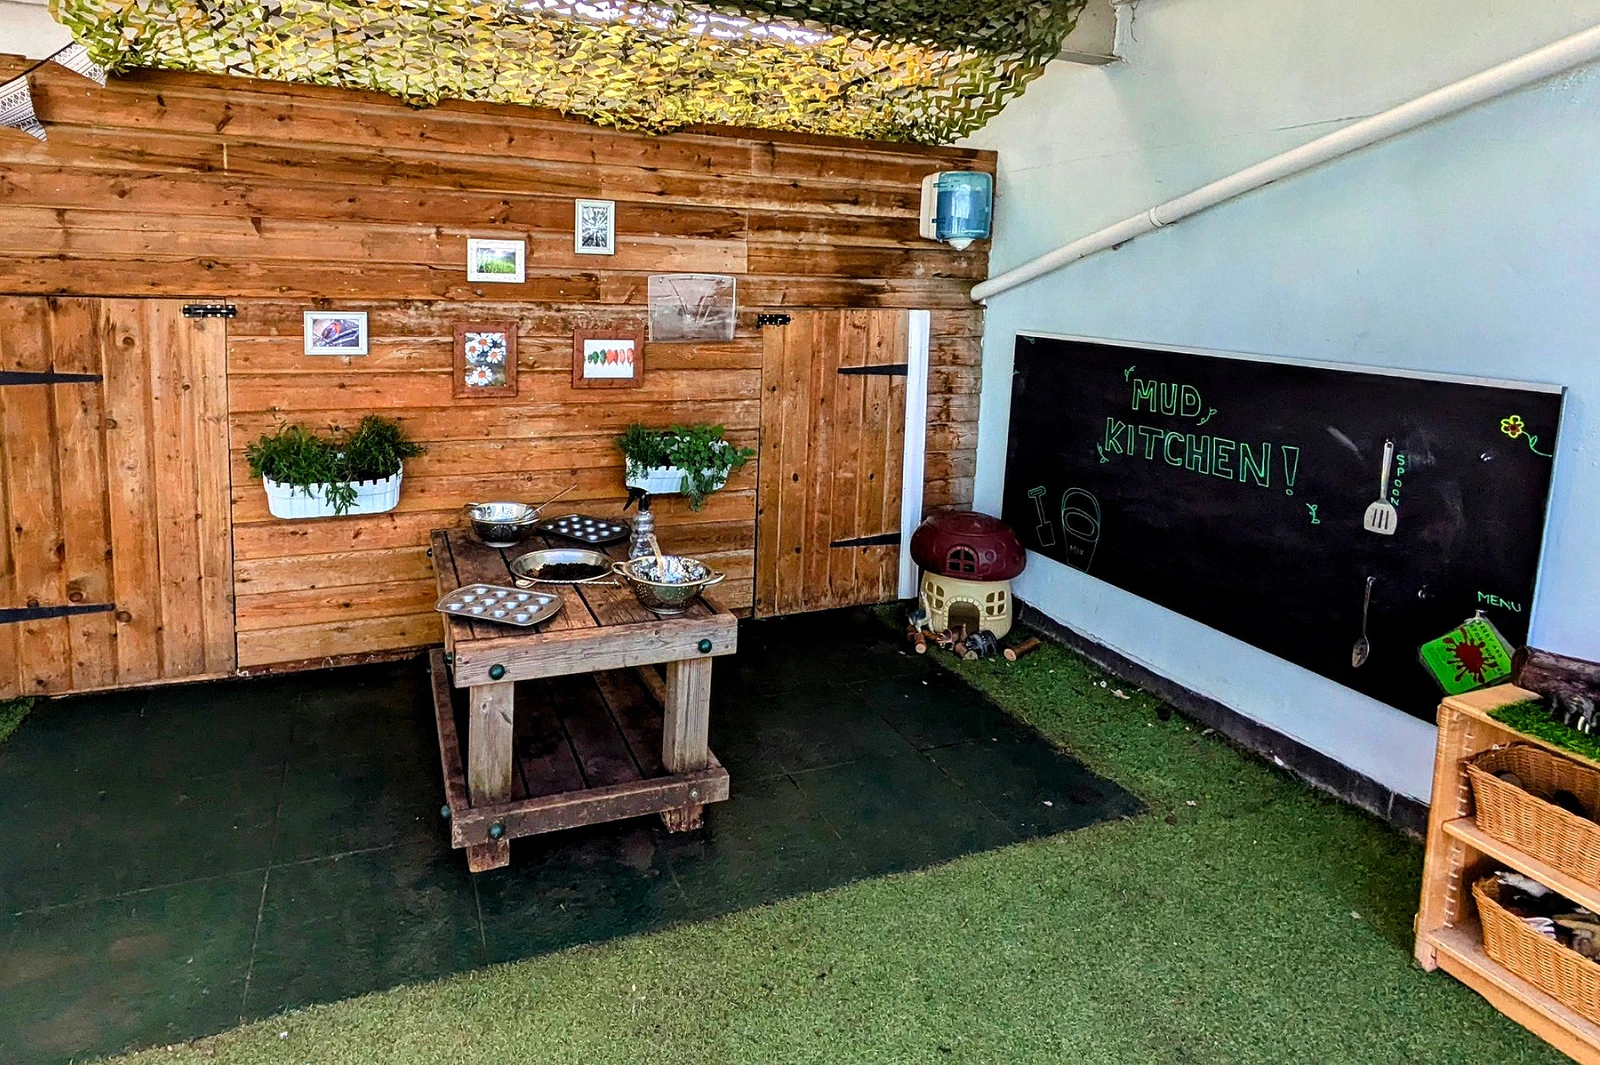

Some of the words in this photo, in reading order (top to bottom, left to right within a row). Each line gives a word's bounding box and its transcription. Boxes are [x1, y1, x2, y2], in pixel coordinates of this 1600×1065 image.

[1131, 378, 1201, 417] MUD
[1390, 454, 1406, 506] SPOON
[1477, 590, 1522, 612] MENU
